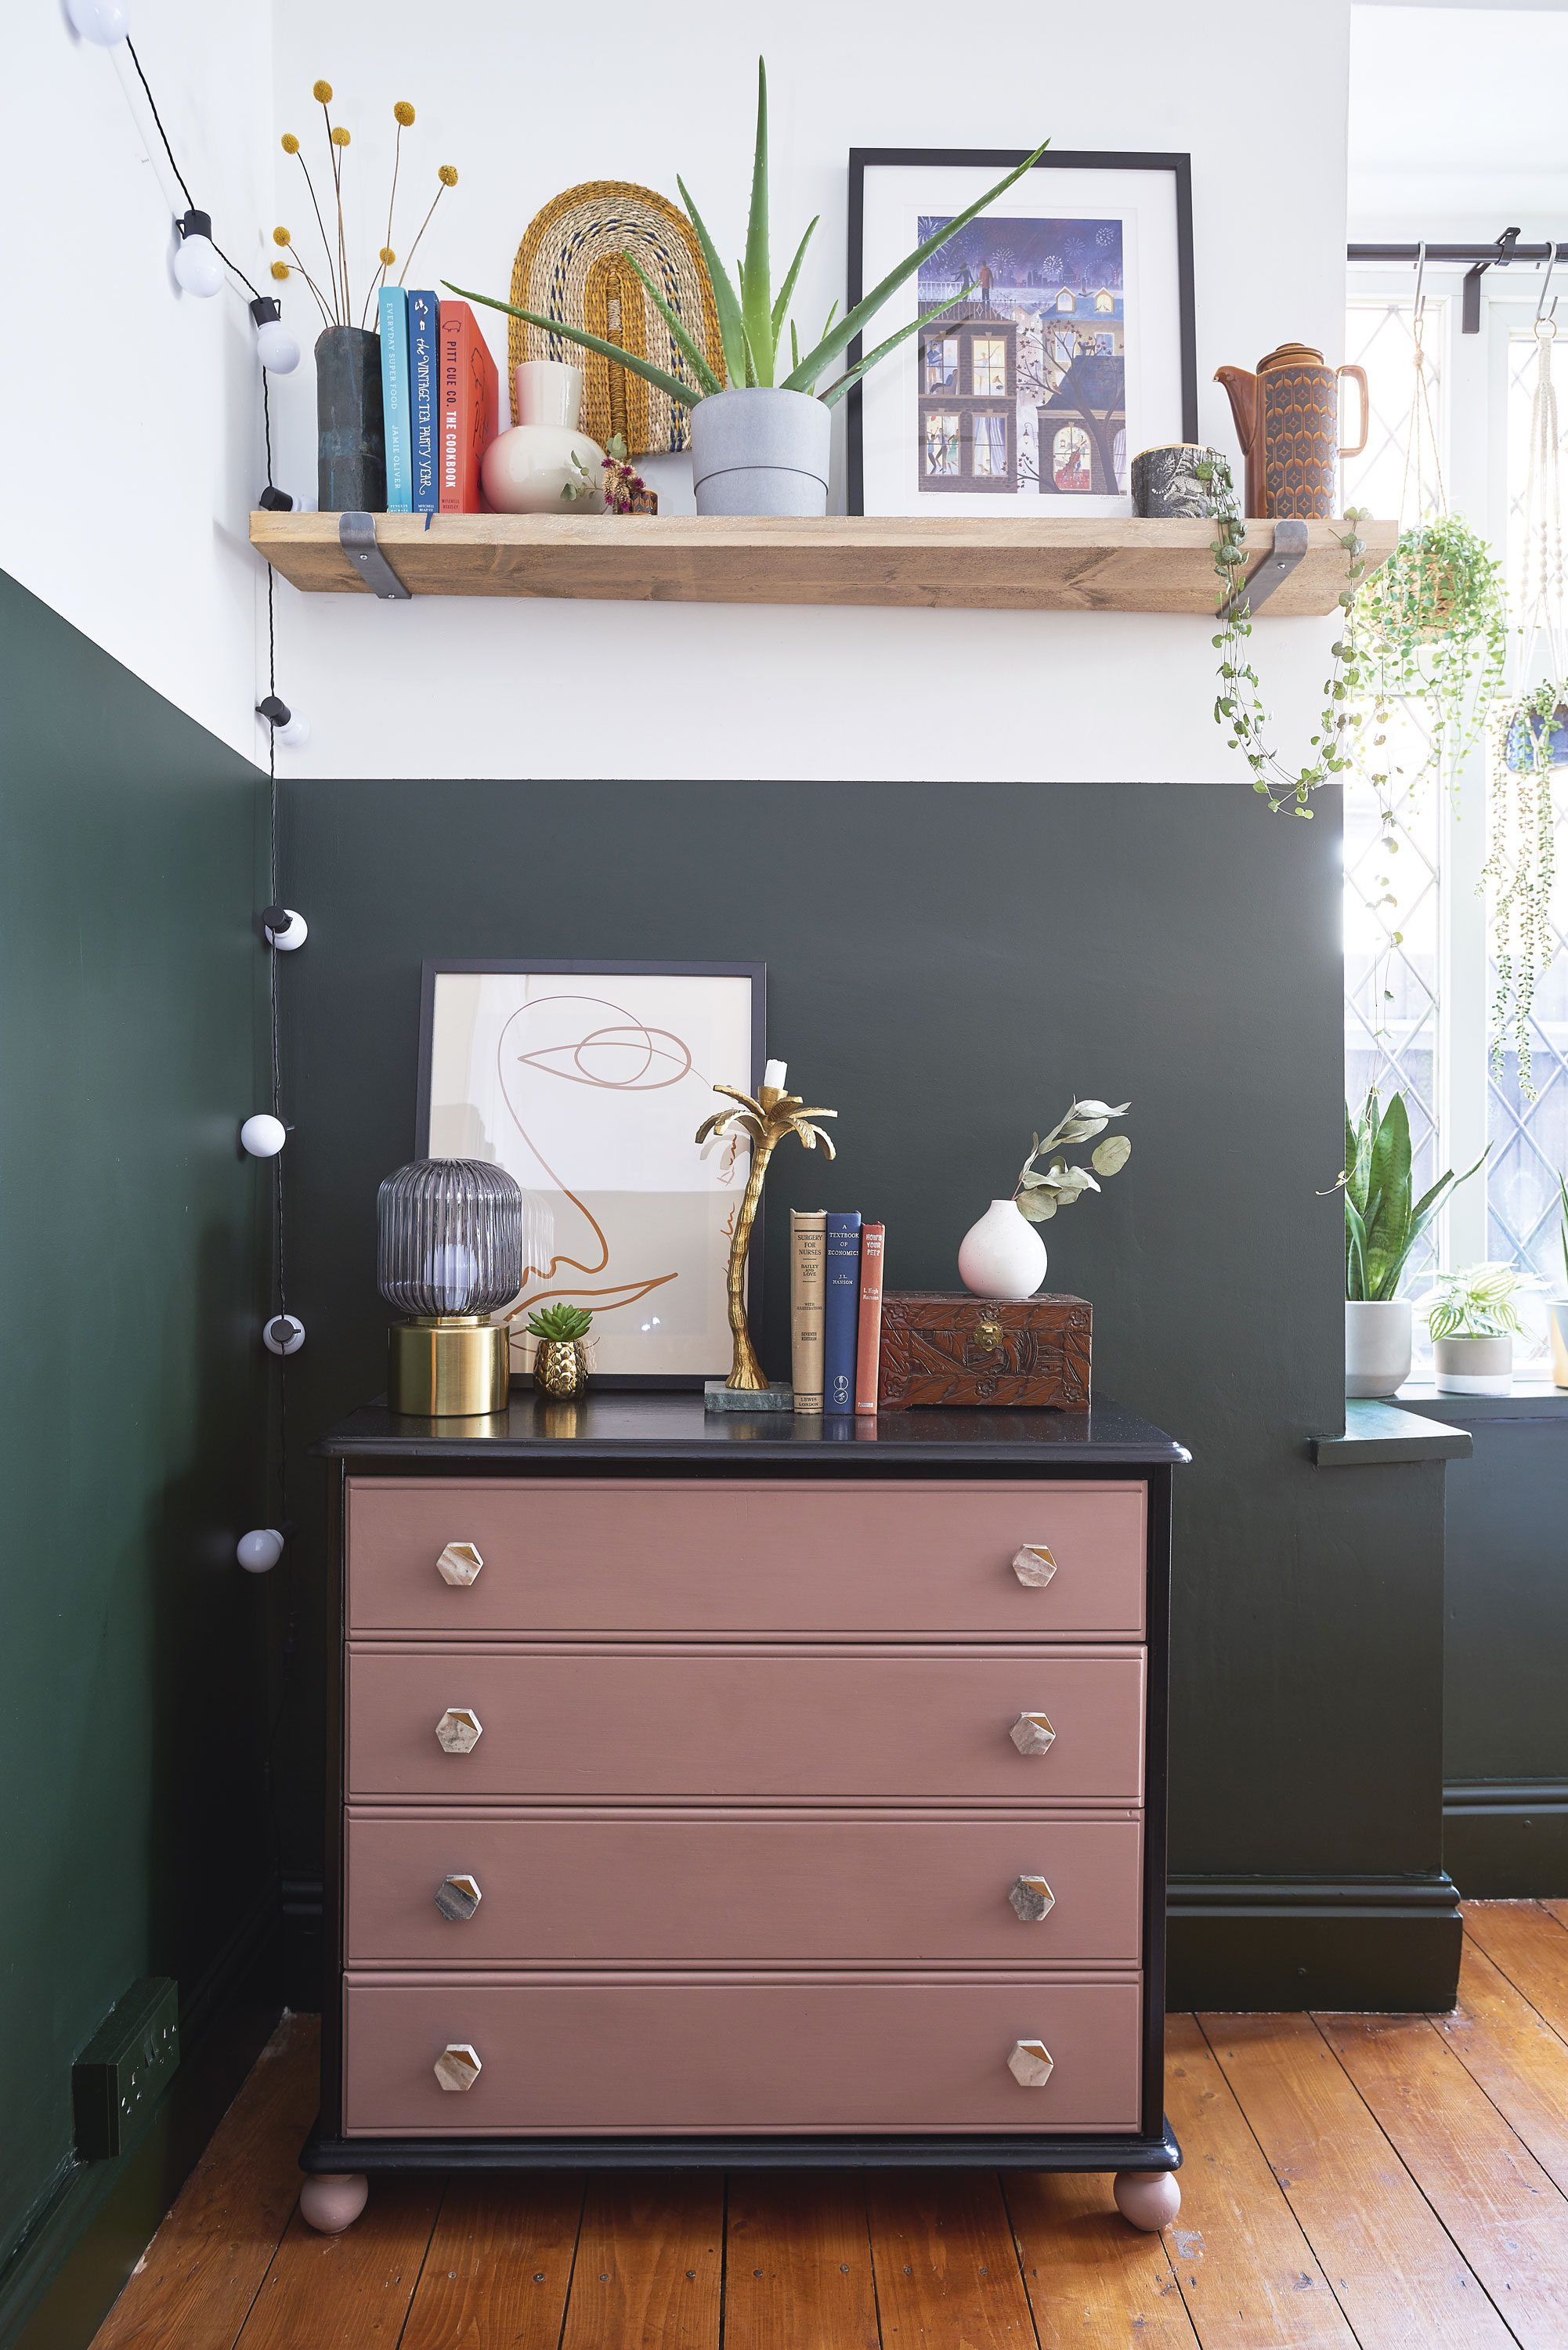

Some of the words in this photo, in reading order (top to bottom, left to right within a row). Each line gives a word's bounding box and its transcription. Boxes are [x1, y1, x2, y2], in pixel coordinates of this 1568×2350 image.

[386, 303, 395, 351] EVERYDAY
[417, 338, 429, 354] the
[446, 341, 457, 362] PITT
[417, 356, 429, 401] VINTAGE
[446, 367, 457, 385] CUE
[446, 391, 457, 407] CO.
[419, 404, 430, 423] TEA
[446, 411, 457, 429] THE
[419, 426, 431, 457] PARTY
[446, 434, 457, 487] COOKBOOK
[419, 461, 431, 495] YEAR
